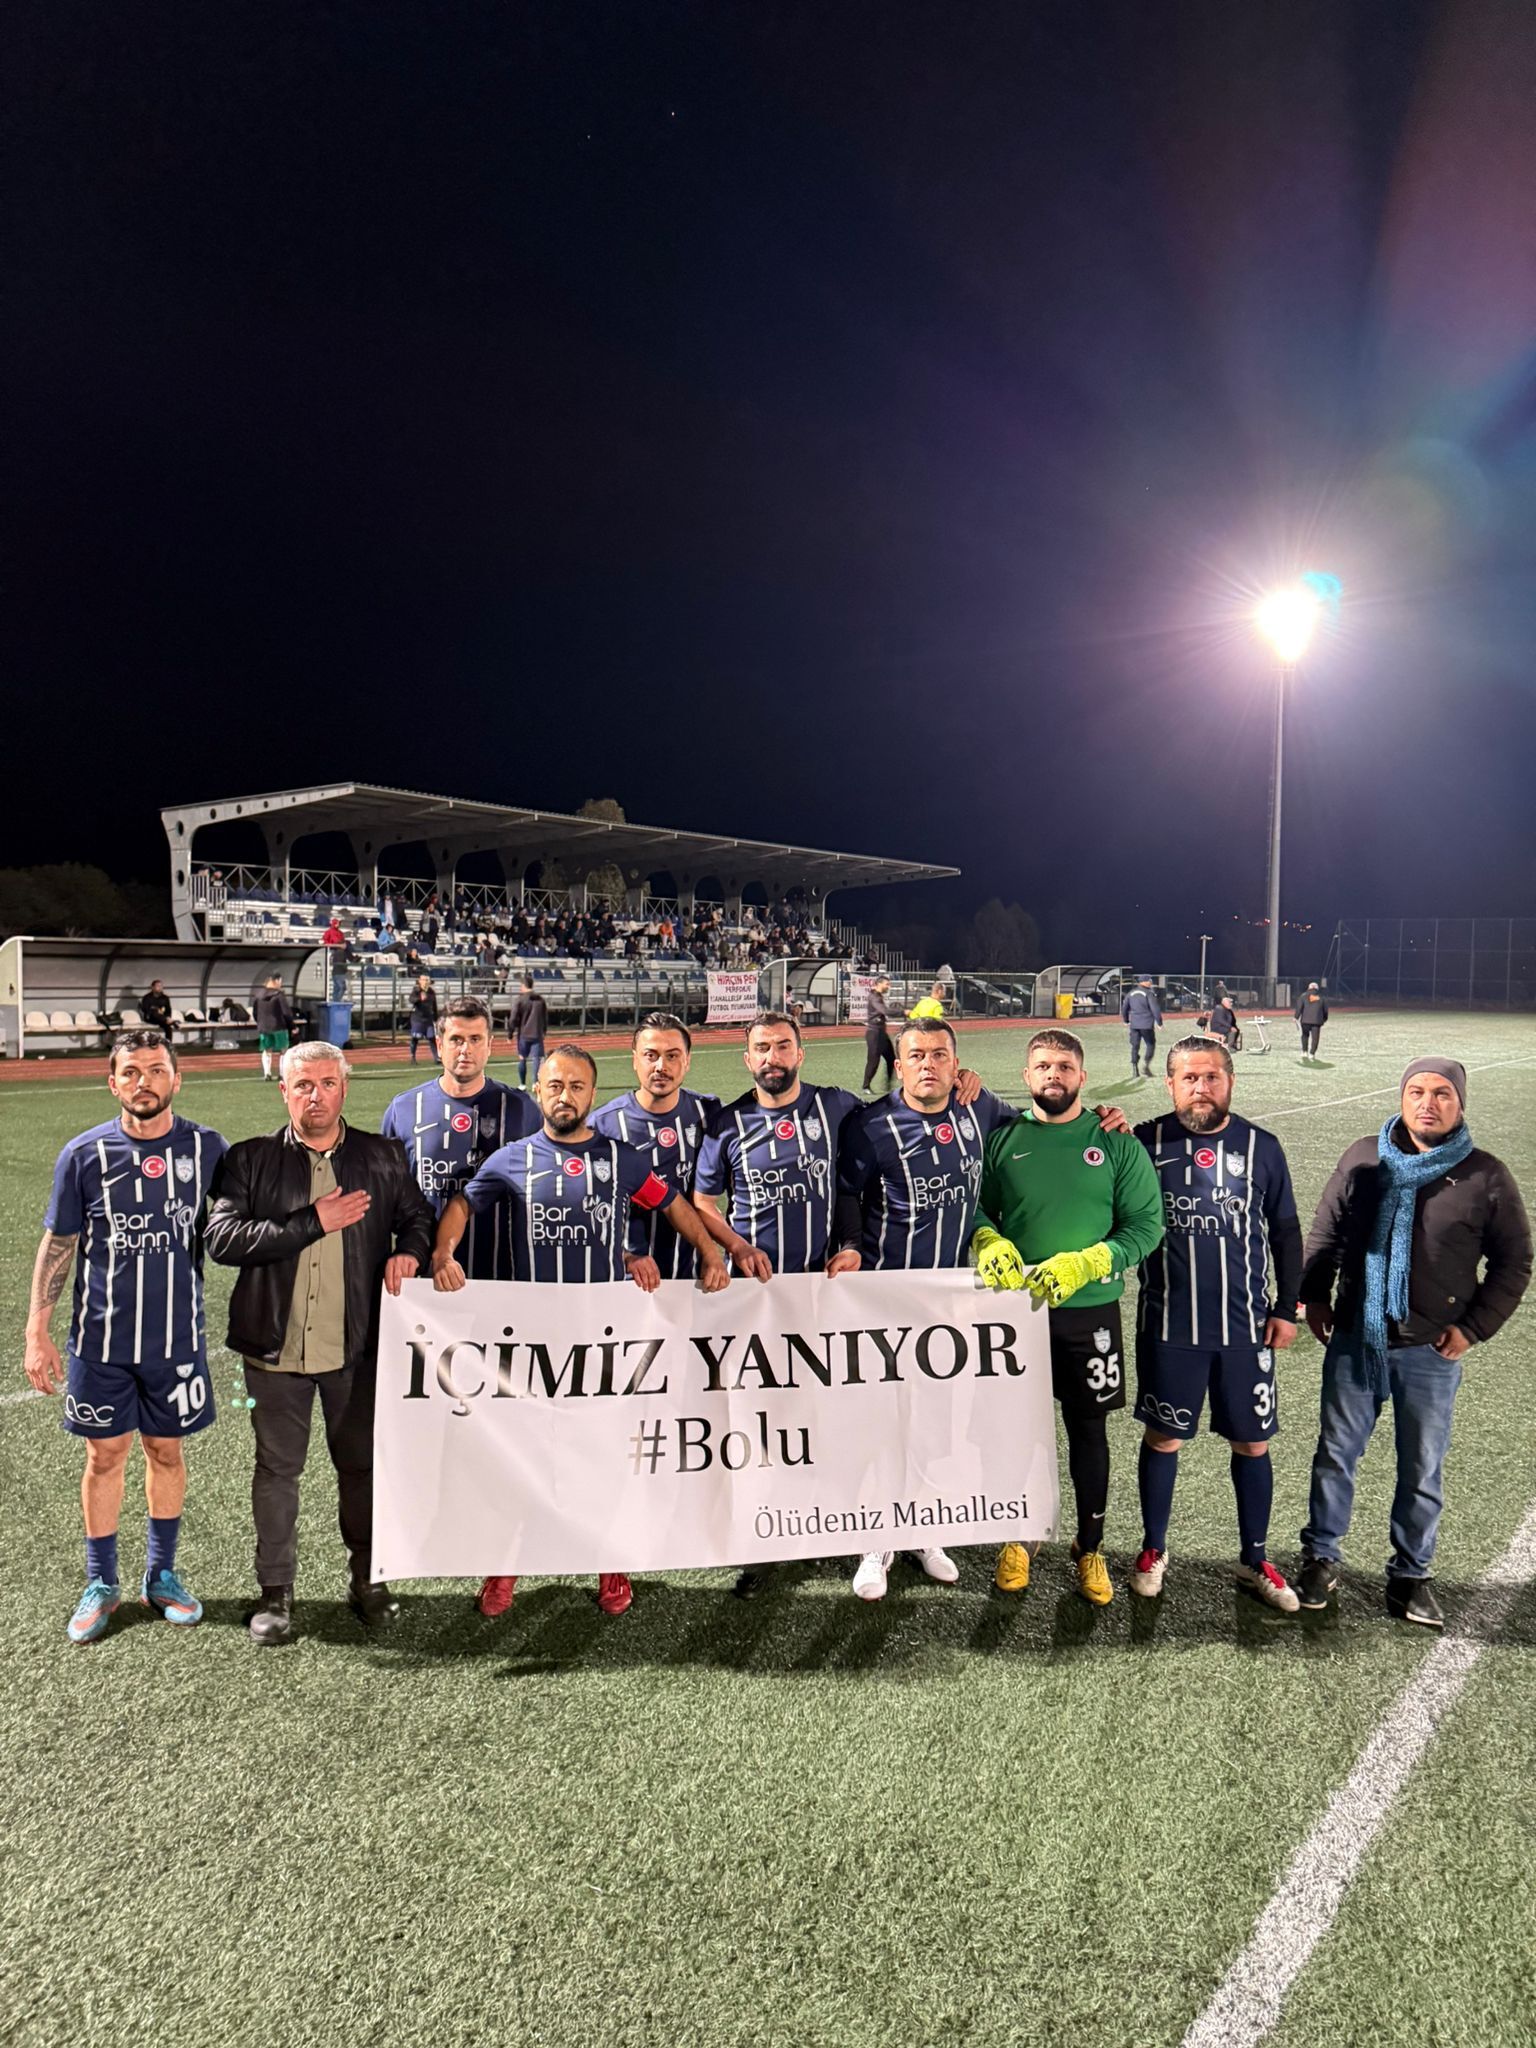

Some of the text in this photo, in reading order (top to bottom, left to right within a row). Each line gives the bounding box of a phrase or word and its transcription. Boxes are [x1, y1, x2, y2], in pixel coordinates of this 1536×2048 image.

[421, 1157, 458, 1174] Bar
[749, 1168, 788, 1185] Bar
[913, 1173, 952, 1193] Bar
[753, 1183, 807, 1201] Bunn
[915, 1185, 966, 1208] Bunn
[1164, 1191, 1202, 1211] Bar
[113, 1212, 153, 1231] Bar
[532, 1203, 572, 1222] Bar
[1166, 1211, 1220, 1229] Bunn
[113, 1231, 170, 1249] Bunn
[532, 1221, 588, 1240] Bunn
[403, 1322, 1026, 1417] İÇİMİZ YANIYOR
[1086, 1352, 1120, 1390] 35
[167, 1375, 206, 1417] 10
[628, 1411, 814, 1475] #Bolu
[754, 1494, 1030, 1541] Ölüdeniz Mahallesi
